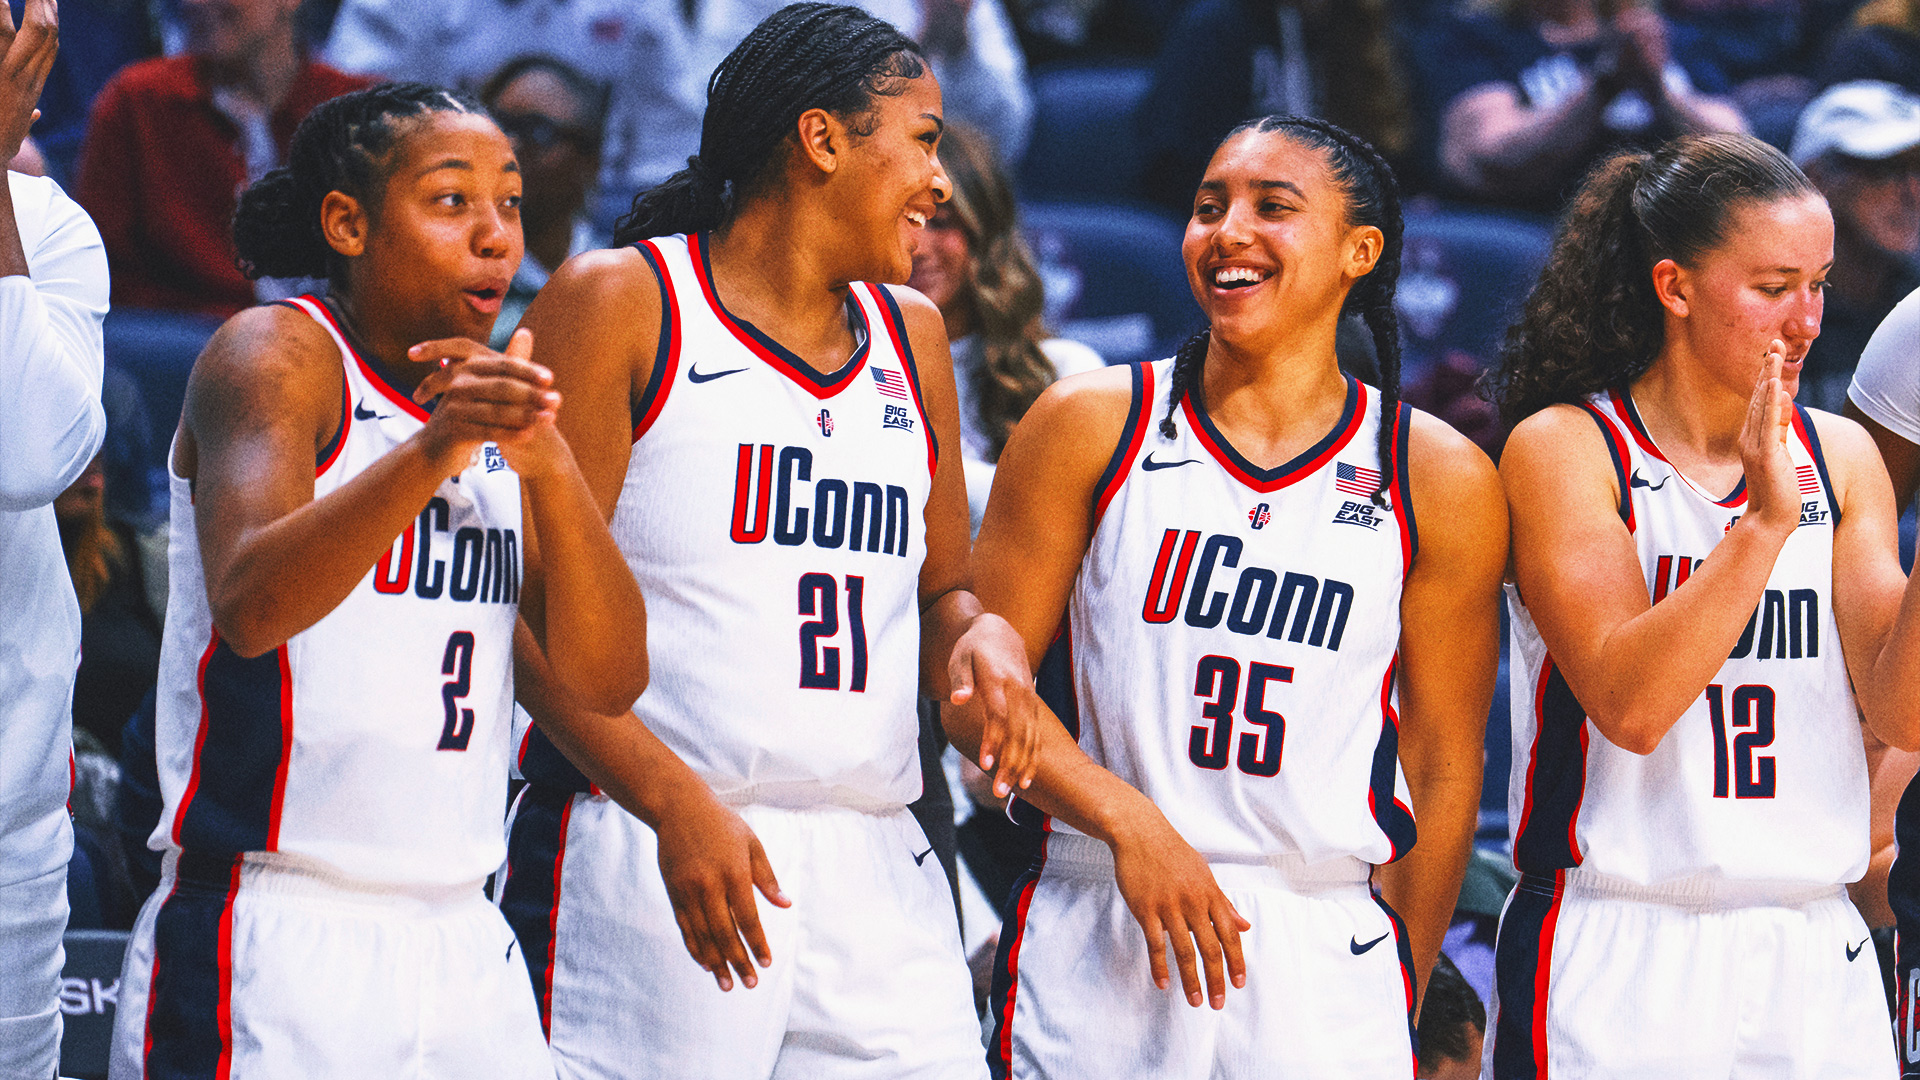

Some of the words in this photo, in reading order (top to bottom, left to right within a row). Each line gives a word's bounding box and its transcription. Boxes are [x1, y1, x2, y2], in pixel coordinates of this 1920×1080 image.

[883, 414, 914, 429] EAST
[885, 404, 907, 418] BIG
[485, 457, 505, 468] EAS
[730, 443, 909, 557] UConn
[1335, 510, 1384, 527] EAST
[1341, 501, 1376, 515] BIG
[1800, 501, 1818, 513] IG
[1800, 510, 1828, 523] AST
[373, 496, 518, 604] UConn
[1142, 528, 1355, 652] UConn
[798, 572, 868, 693] 21
[436, 630, 475, 751] 2
[1188, 654, 1294, 778] 35
[1706, 684, 1776, 799] 12
